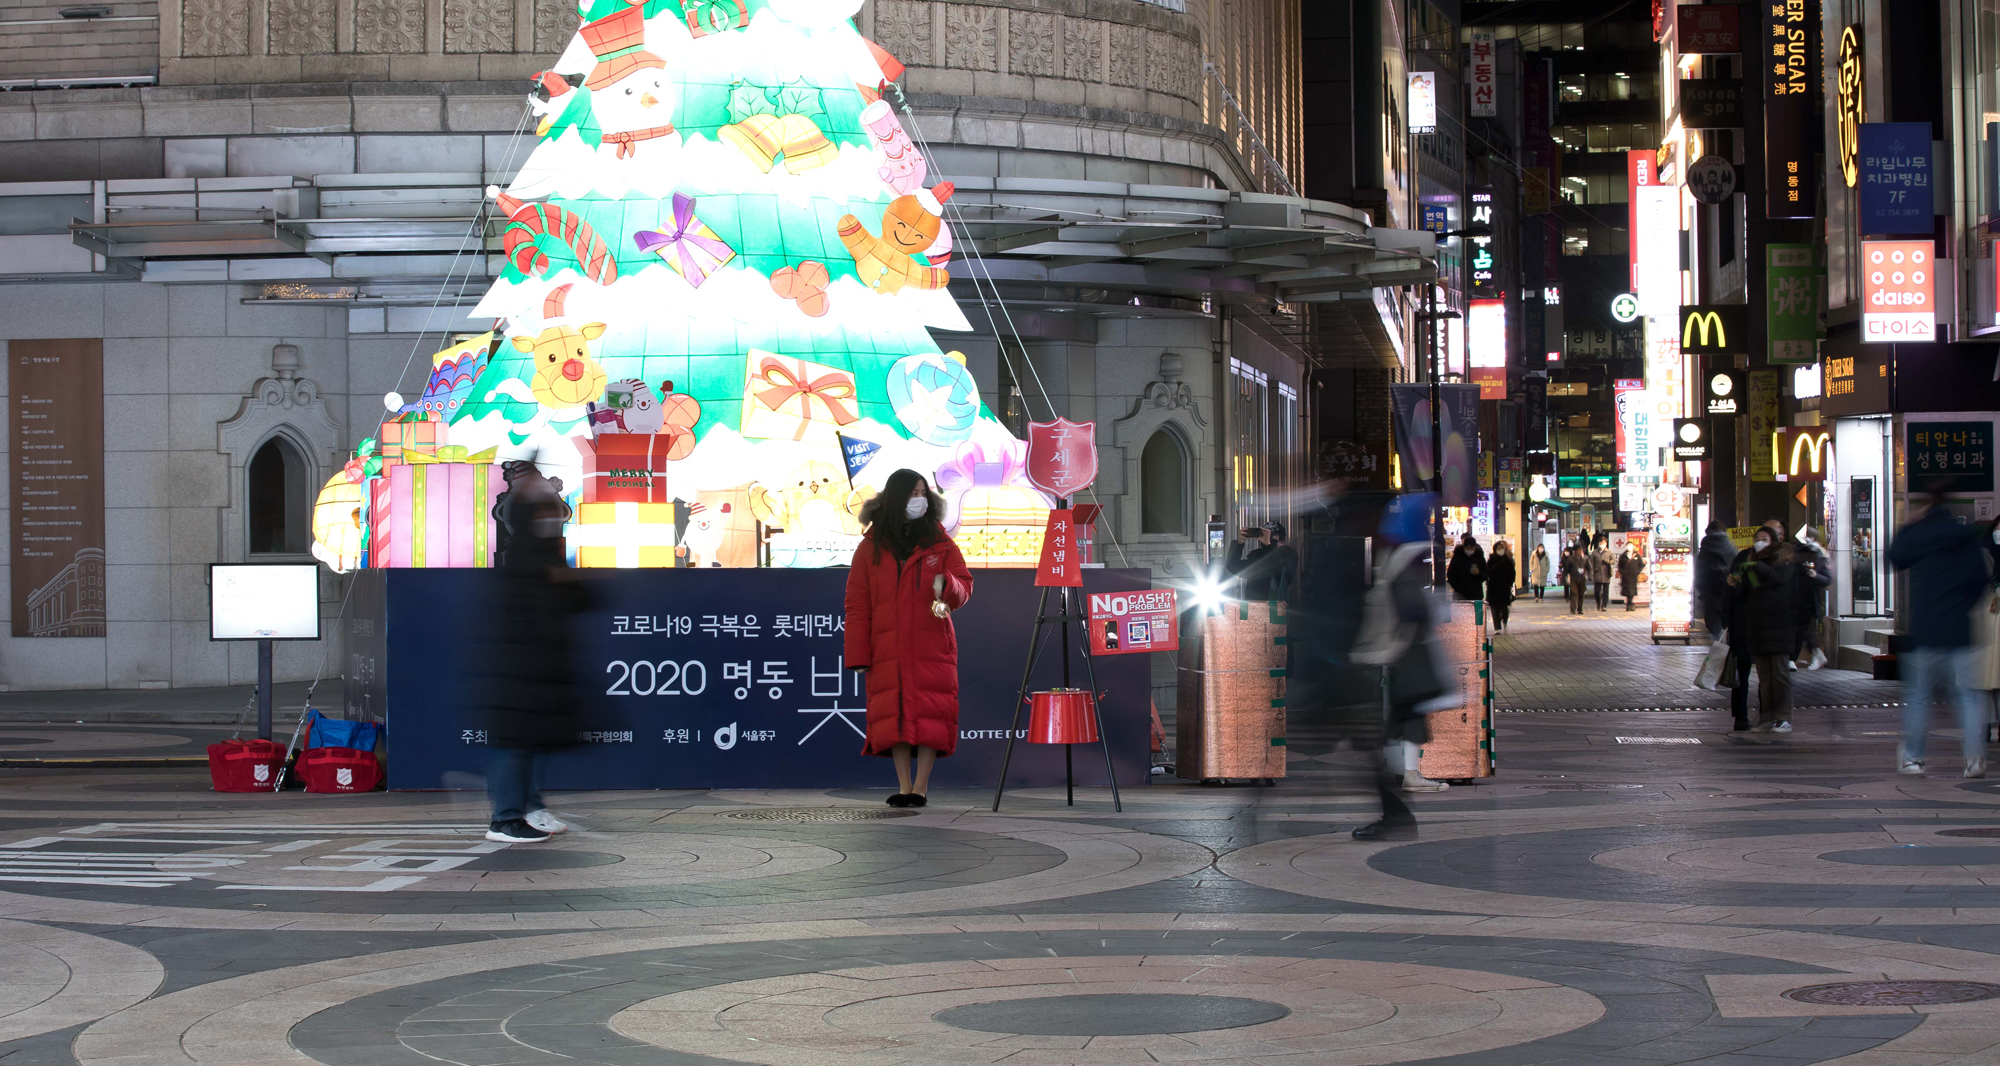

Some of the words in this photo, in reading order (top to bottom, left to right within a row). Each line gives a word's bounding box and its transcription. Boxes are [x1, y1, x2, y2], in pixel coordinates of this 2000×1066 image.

[1683, 9, 1695, 18] 4F
[1787, 29, 1806, 94] SUGAR
[1474, 42, 1494, 105] 부동산
[1686, 87, 1735, 100] Korea
[1703, 102, 1735, 116] Spa
[1866, 157, 1927, 170] 라임나무
[1636, 159, 1648, 185] RED
[1867, 173, 1927, 186] 치과병원
[1787, 160, 1799, 202] 명동점
[1472, 194, 1491, 202] STAR
[1889, 190, 1907, 204] 7F
[1426, 211, 1444, 221] 번역
[1473, 271, 1492, 280] Cafe
[1773, 276, 1811, 316] 粥
[1871, 288, 1926, 306] daiso
[1868, 320, 1930, 335] 다이소
[1915, 431, 1968, 447] 티안나
[846, 441, 871, 455] VISIT
[850, 452, 875, 468] SEOUL
[1050, 428, 1073, 488] 구세군
[1917, 452, 1986, 470] 성형외과
[609, 468, 654, 479] MERRY
[607, 480, 656, 488] MEDIHEAL
[1656, 490, 1678, 512] 약
[1732, 527, 1757, 535] MONEY
[1051, 520, 1068, 578] 자선냄비
[1091, 594, 1129, 616] NO
[1128, 592, 1172, 605] CASH?
[1129, 602, 1171, 611] PROBLEM
[610, 614, 692, 638] 코로나19
[699, 614, 761, 638] 극복은
[606, 659, 707, 696] 2020
[723, 659, 794, 700] 명동
[460, 728, 489, 745] 주최
[662, 727, 690, 744] 후원
[741, 729, 776, 742] 서울중구
[960, 729, 1004, 740] LOTTE
